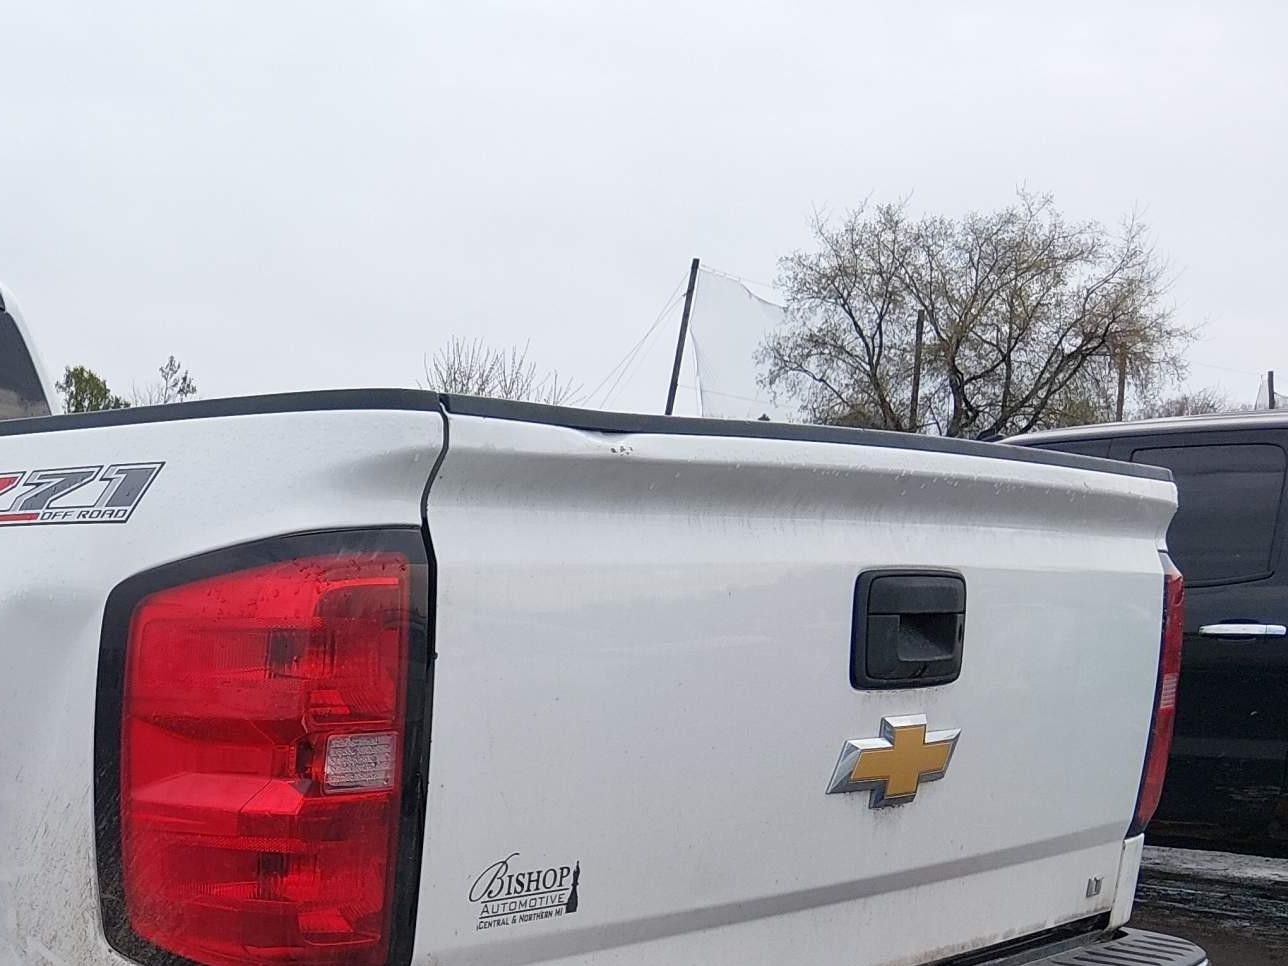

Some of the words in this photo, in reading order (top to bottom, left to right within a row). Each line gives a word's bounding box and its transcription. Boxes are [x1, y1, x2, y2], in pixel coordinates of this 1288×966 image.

[40, 510, 73, 521] OFF
[76, 508, 128, 520] ROAD
[480, 893, 566, 916] AUTOMOTIVE
